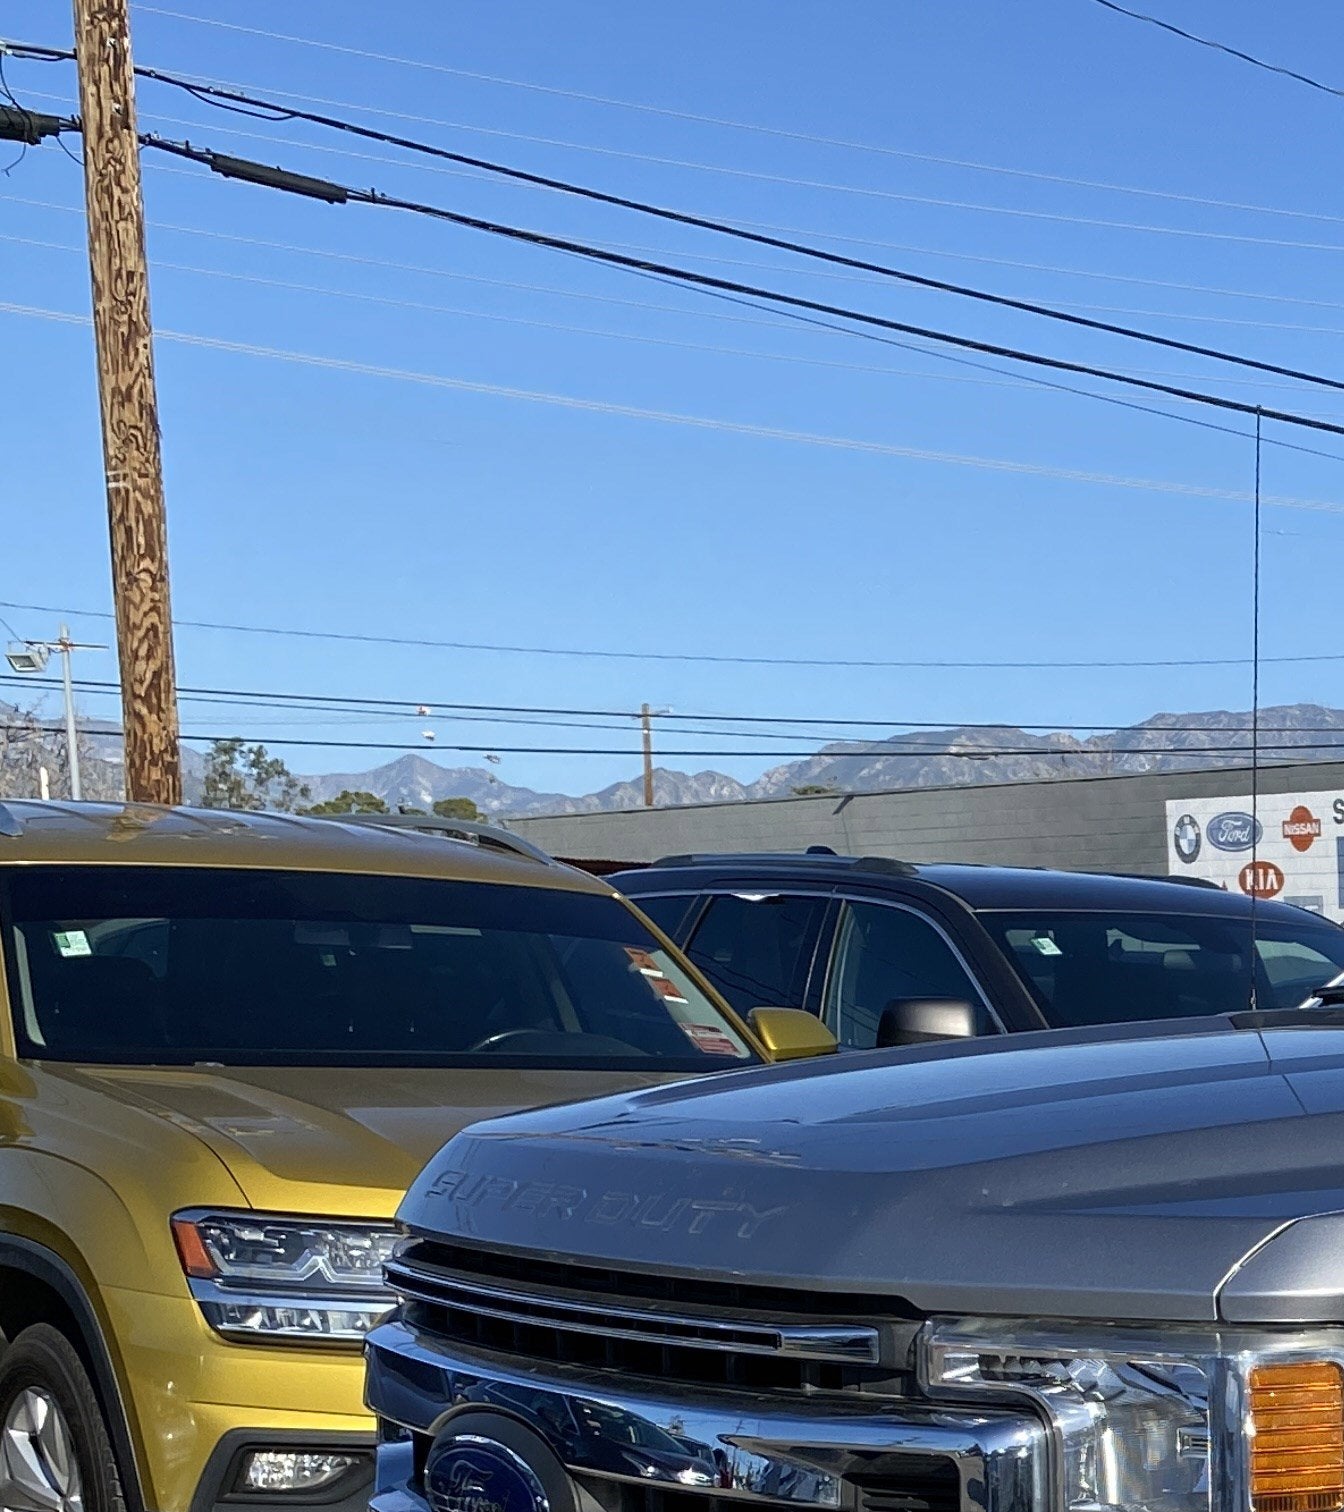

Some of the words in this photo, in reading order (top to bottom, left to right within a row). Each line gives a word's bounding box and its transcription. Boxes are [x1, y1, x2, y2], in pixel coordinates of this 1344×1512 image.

[1218, 819, 1251, 843] Ford
[1283, 822, 1320, 836] NISSAN
[1245, 868, 1279, 891] KIA
[425, 1168, 588, 1221] SUPER
[595, 1190, 791, 1240] DUTY
